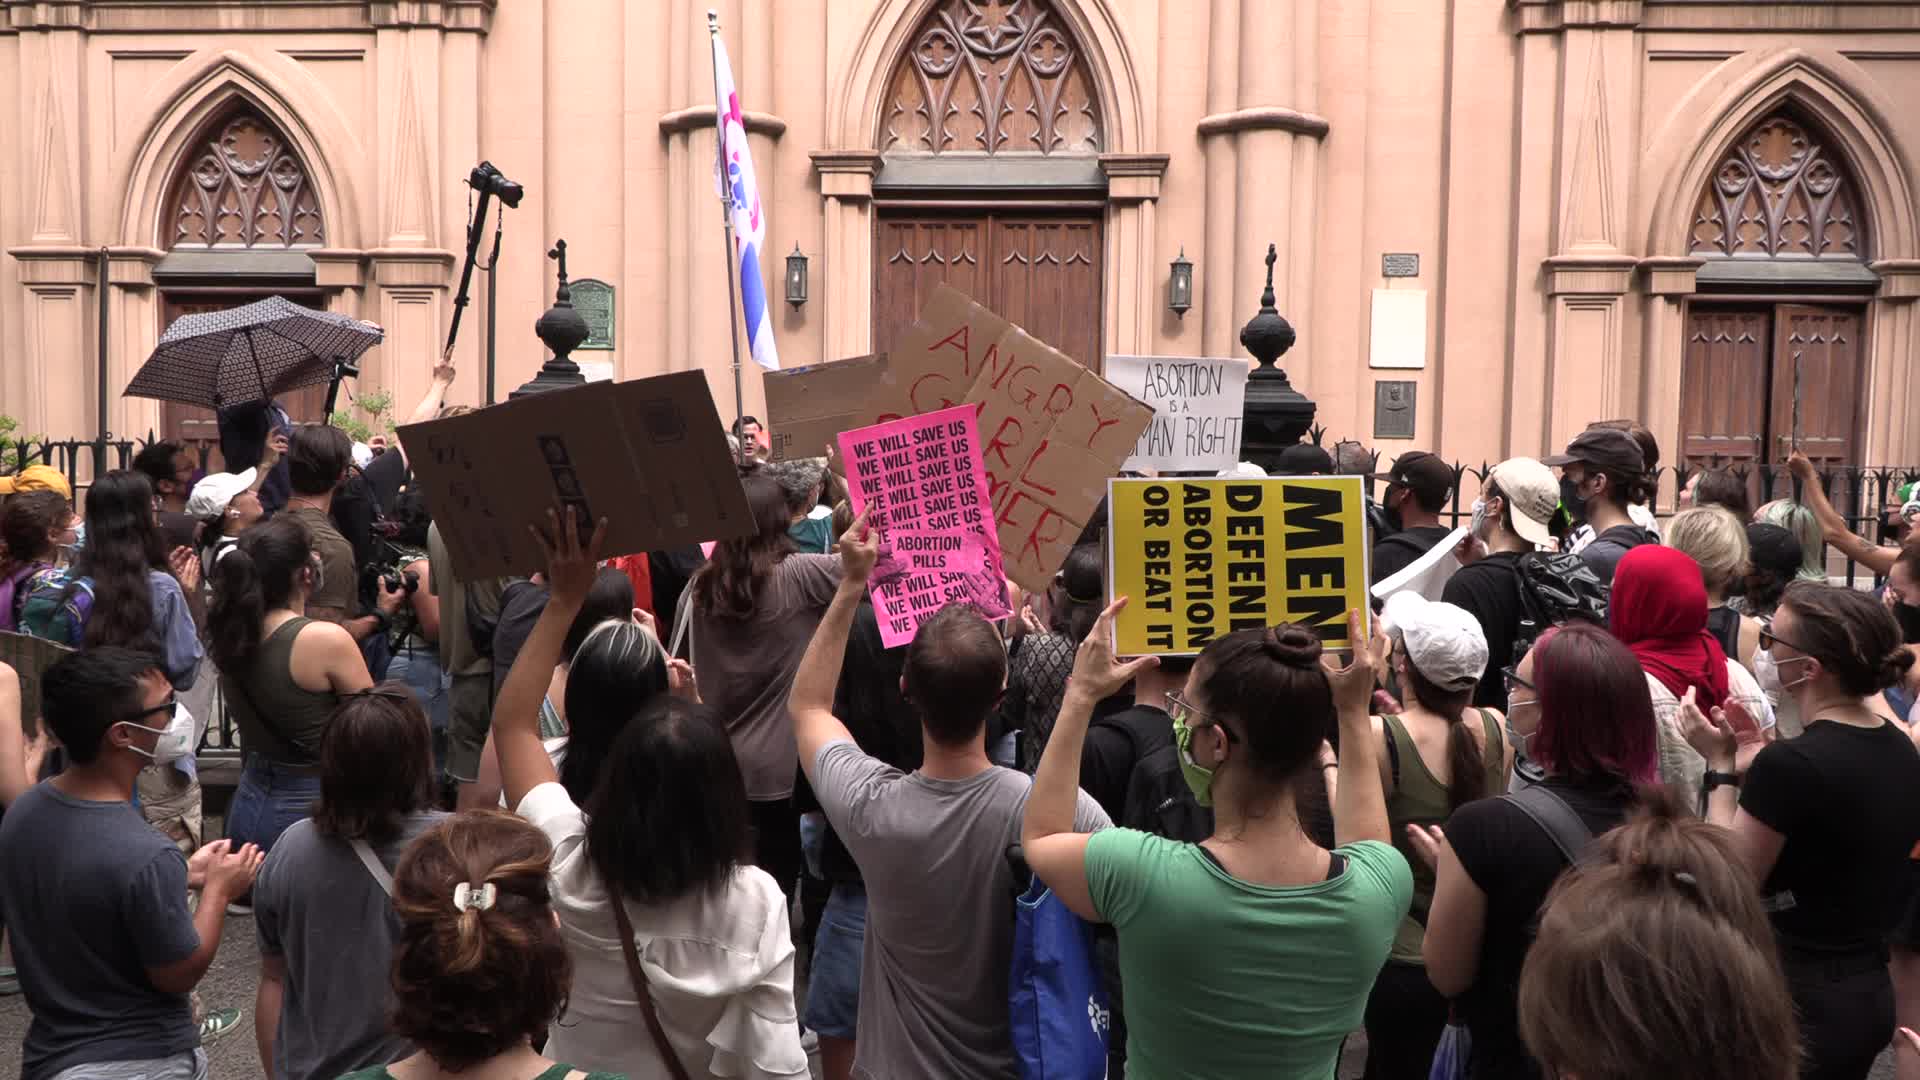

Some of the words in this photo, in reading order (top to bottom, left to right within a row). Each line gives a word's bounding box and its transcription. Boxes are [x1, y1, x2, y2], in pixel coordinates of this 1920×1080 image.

[928, 325, 1120, 449] ANGRY
[1143, 362, 1223, 400] ABORTION
[1169, 400, 1178, 412] IS
[1182, 400, 1190, 412] A
[854, 441, 876, 459] WE
[878, 433, 910, 453] WILL
[912, 424, 945, 445] SAVE
[948, 420, 966, 437] US
[1129, 416, 1177, 457] MAN
[1185, 416, 1242, 457] RIGHT
[857, 459, 879, 477] WE
[882, 451, 912, 470] WILL
[915, 442, 948, 463] SAVE
[951, 438, 969, 454] US
[860, 477, 882, 495] WE
[885, 469, 915, 488] WILL
[918, 460, 951, 480] SAVE
[954, 455, 972, 472] US
[888, 486, 918, 505] WILL
[921, 477, 953, 498] SAVE
[956, 473, 975, 489] US
[1143, 485, 1170, 529] OR
[868, 512, 889, 528] WE
[890, 503, 922, 523] WILL
[924, 495, 957, 515] SAVE
[959, 490, 978, 507] US
[928, 512, 961, 530] SAVE
[963, 508, 982, 524] US
[896, 536, 962, 551] ABORTION
[912, 554, 947, 569] PILLS
[1282, 484, 1348, 641] MEN
[1144, 540, 1172, 613] BEAT
[1183, 483, 1215, 648] ABORTION
[880, 582, 903, 599] WE
[905, 573, 937, 593] WILL
[885, 599, 907, 617] WE
[909, 591, 942, 612] WILL
[890, 616, 912, 635] WE
[1146, 624, 1174, 650] IT
